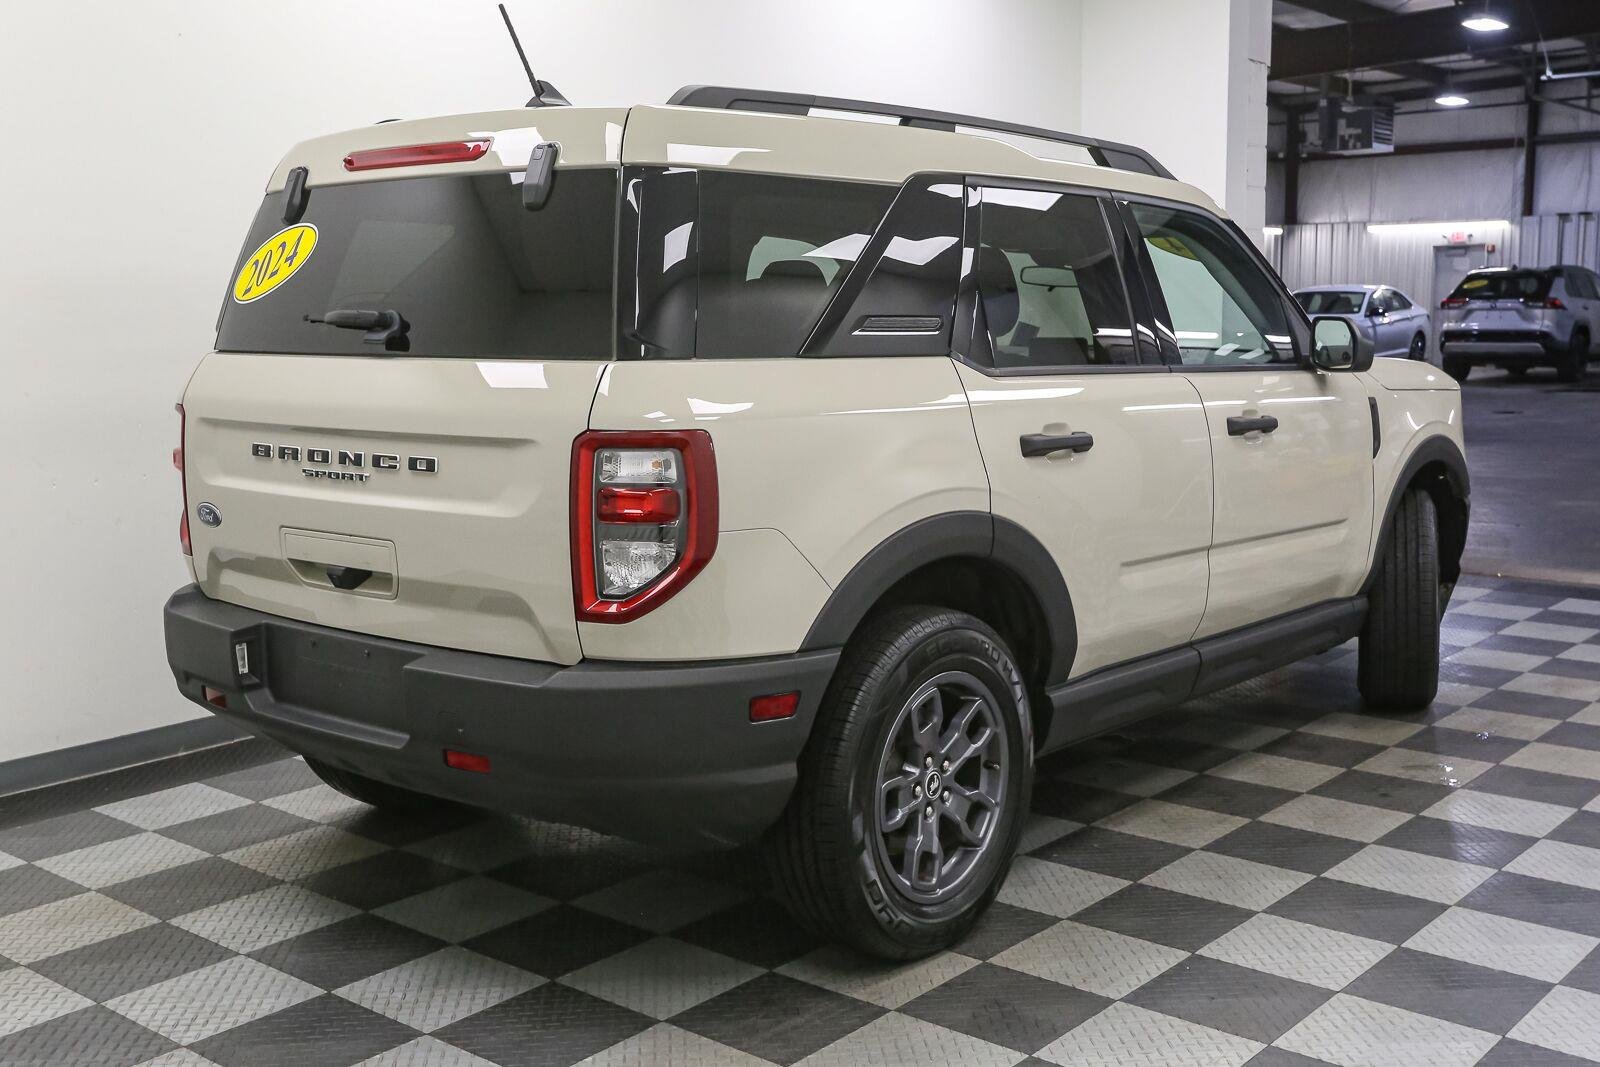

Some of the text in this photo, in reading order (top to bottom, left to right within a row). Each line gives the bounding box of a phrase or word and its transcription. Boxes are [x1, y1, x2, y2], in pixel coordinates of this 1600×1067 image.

[241, 229, 305, 298] 2024
[252, 442, 439, 473] BRONCO
[301, 467, 371, 483] SPORT
